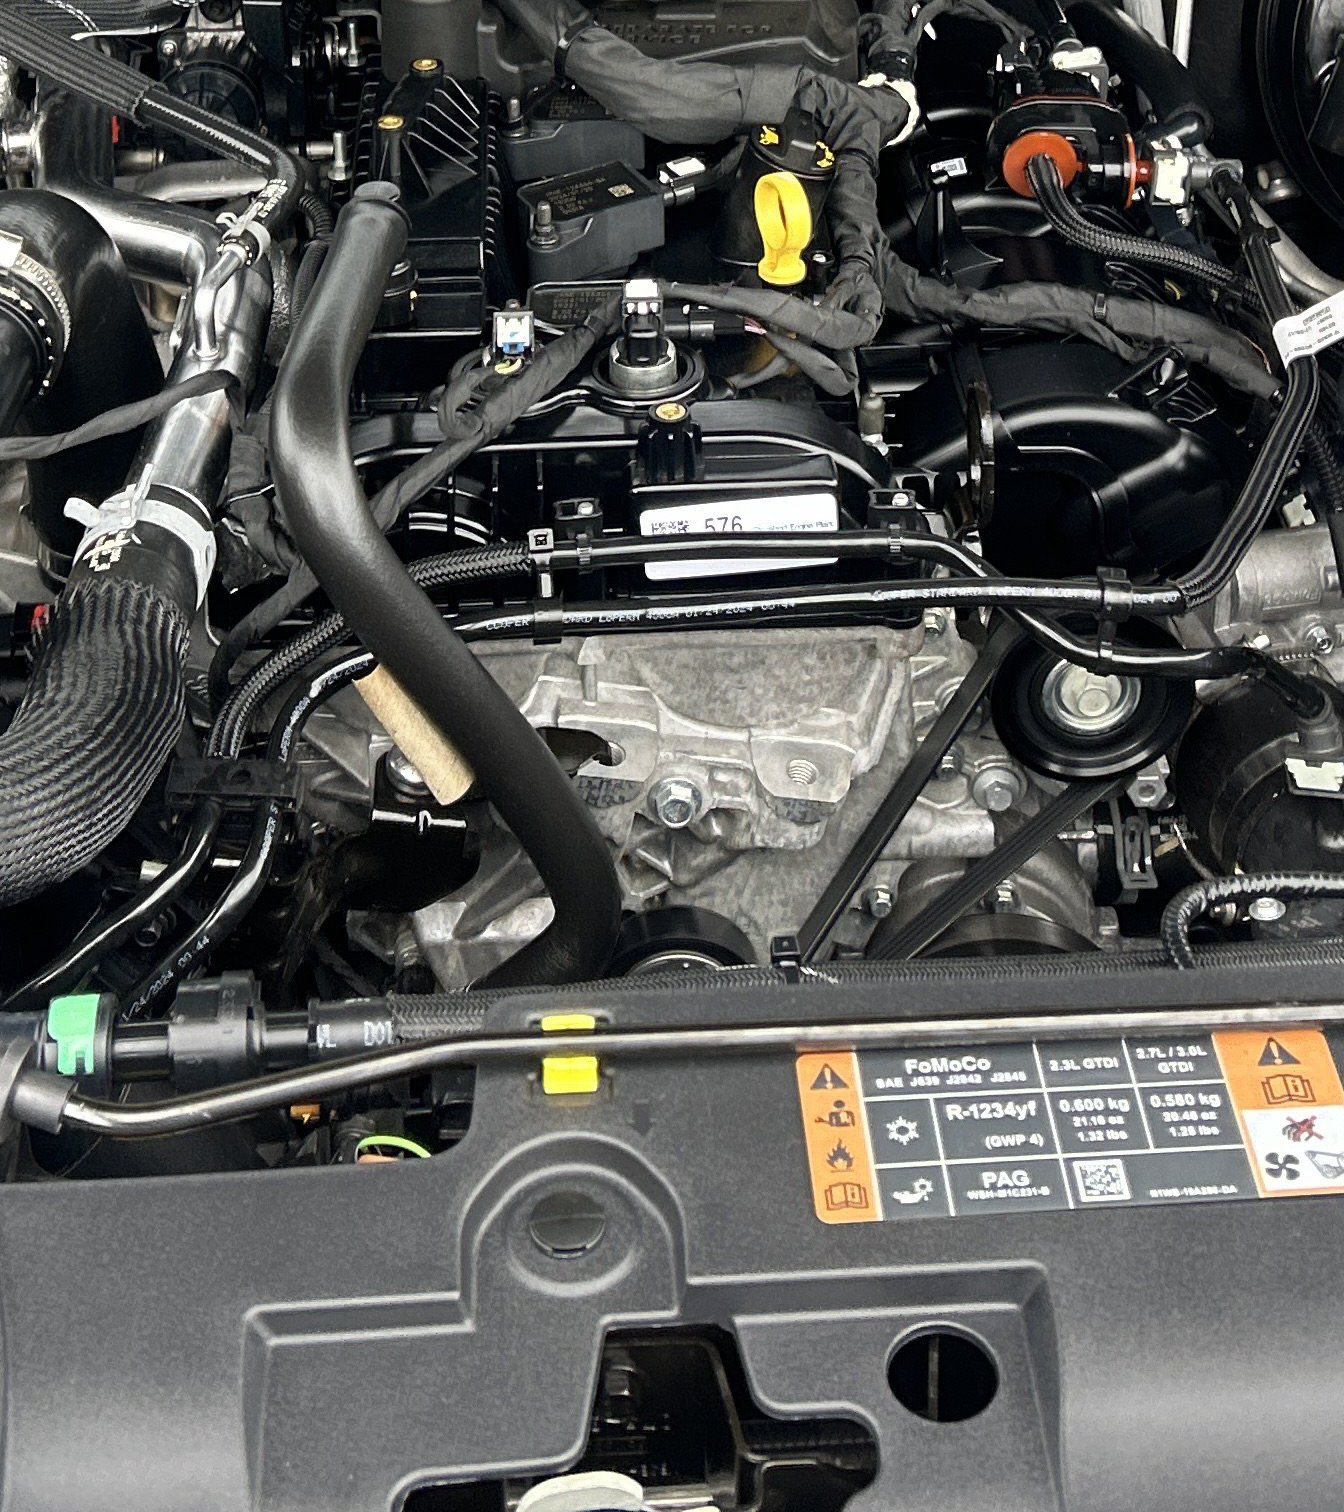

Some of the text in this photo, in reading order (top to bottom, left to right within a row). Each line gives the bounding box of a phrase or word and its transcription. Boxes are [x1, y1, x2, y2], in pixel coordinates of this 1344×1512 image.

[1135, 1047, 1166, 1060] 2.7L
[1176, 1045, 1208, 1058] 3.0L
[905, 1055, 991, 1075] FoMoCo
[1049, 1056, 1119, 1072] 2.3L GTDI
[1157, 1061, 1194, 1074] GTDI
[875, 1077, 904, 1089] SAE
[1059, 1097, 1130, 1113] 0.600 kg
[1149, 1092, 1221, 1108] 0.580 kg
[945, 1100, 1037, 1121] R-1234yf
[1201, 1111, 1218, 1120] oz
[1108, 1115, 1125, 1125] oz
[1077, 1129, 1128, 1142] 1.32 lbs
[1198, 1125, 1220, 1136] lbs
[985, 1133, 1044, 1150] (GWP 4)
[981, 1169, 1030, 1189] PAG
